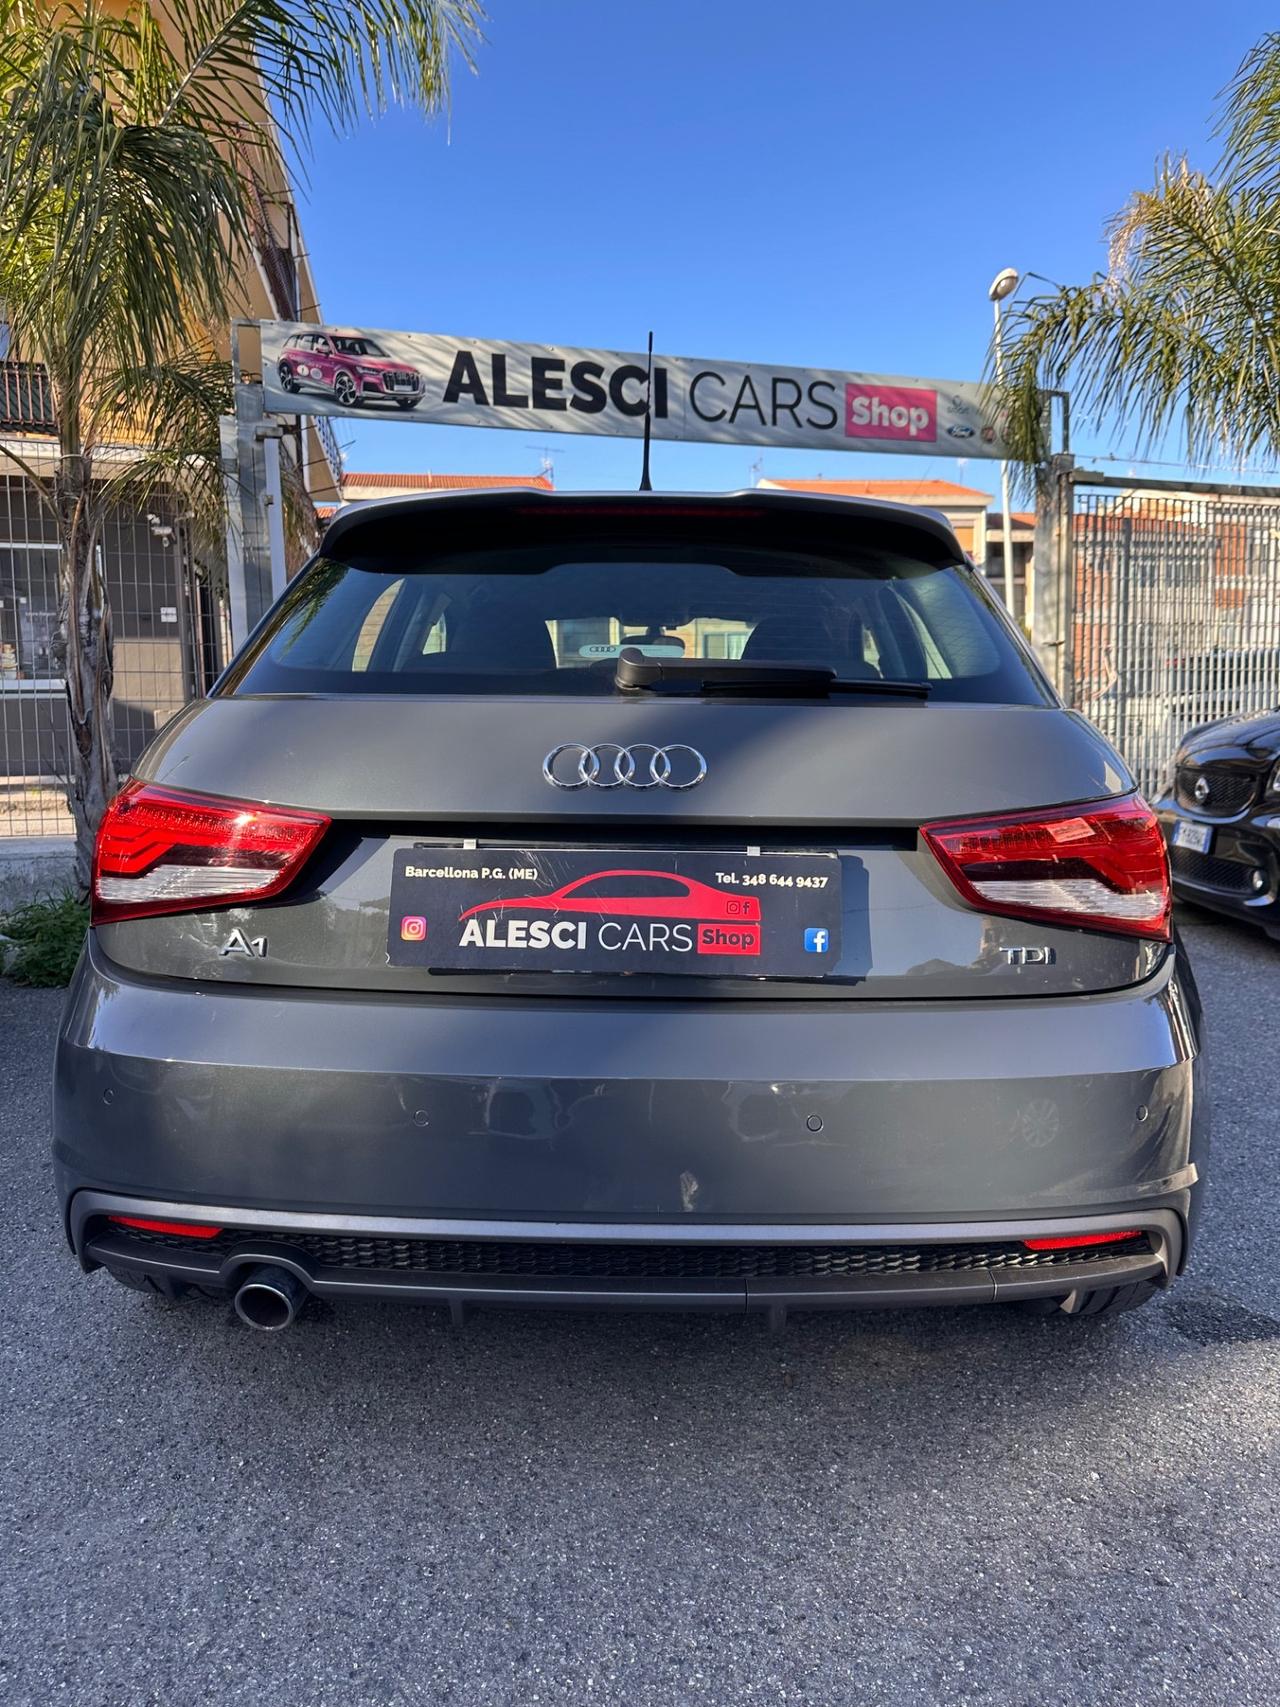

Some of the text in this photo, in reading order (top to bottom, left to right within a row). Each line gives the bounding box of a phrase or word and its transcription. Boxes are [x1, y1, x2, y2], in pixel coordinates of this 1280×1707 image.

[443, 350, 838, 430] ALESCI CARS
[851, 396, 929, 435] Shop
[405, 865, 538, 881] Barcellona P.G. (ME)
[742, 873, 767, 886] 348
[769, 875, 794, 887] 644
[795, 876, 829, 888] 9437
[219, 927, 268, 958] A1
[458, 919, 693, 952] ALESCI CARS
[702, 928, 755, 950] Shop
[999, 946, 1056, 966] TDI
